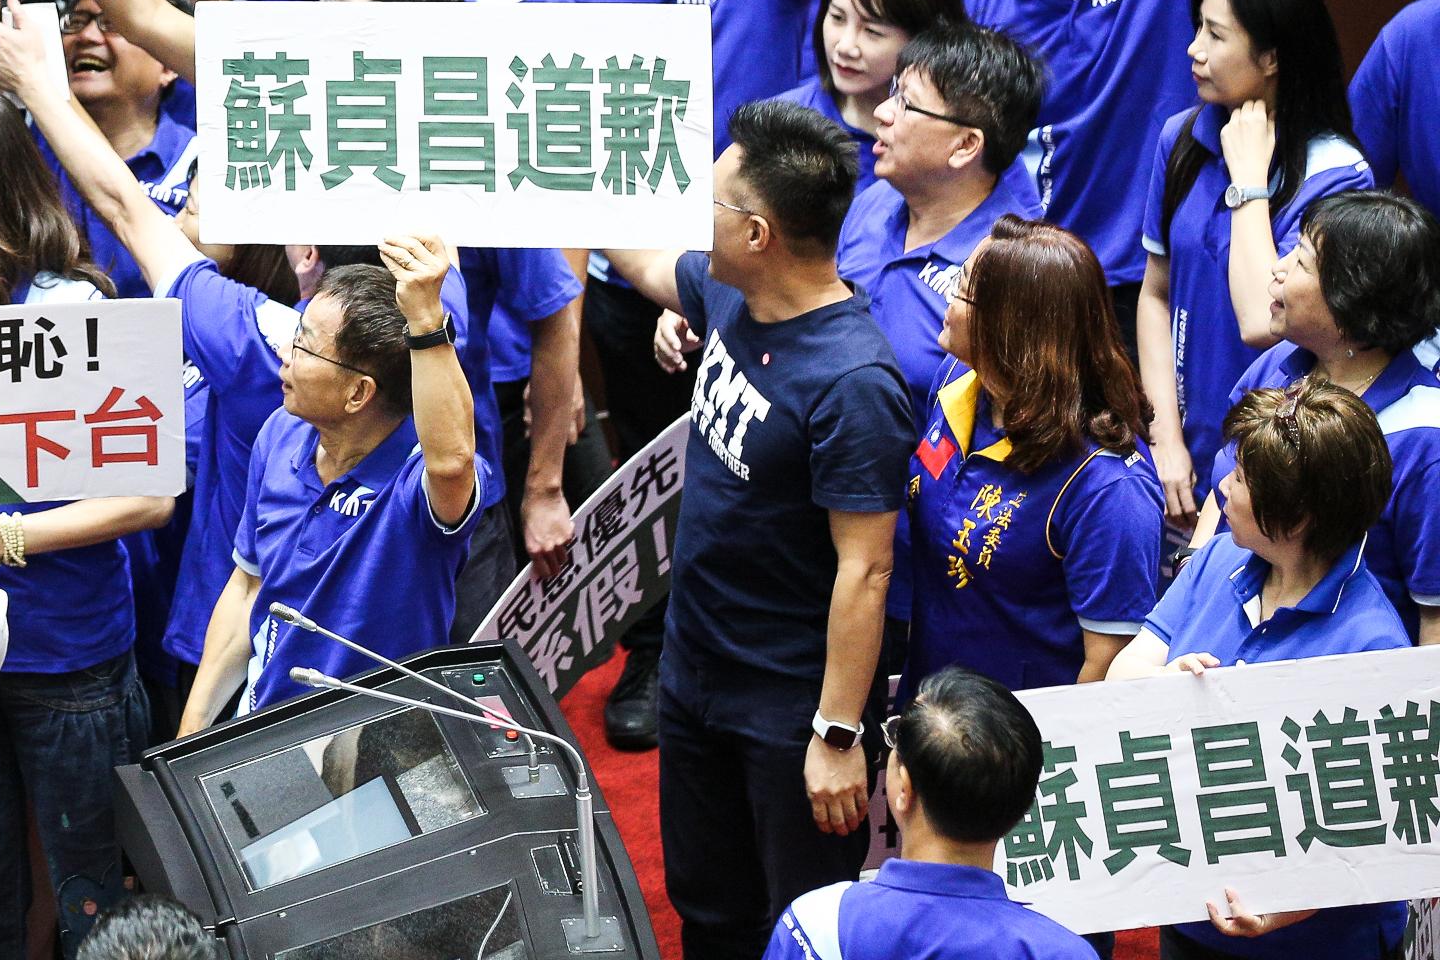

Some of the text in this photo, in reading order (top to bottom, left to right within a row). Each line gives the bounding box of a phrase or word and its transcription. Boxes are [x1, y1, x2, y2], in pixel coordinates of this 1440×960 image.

[222, 51, 691, 195] 蘇貞昌道歉
[138, 180, 189, 205] KMT
[918, 261, 954, 296] KM
[691, 327, 772, 459] KMT
[708, 426, 750, 481] TOGETHER
[947, 484, 1002, 589] 陳玉珍
[976, 490, 1028, 570] 立法委員
[1003, 700, 1440, 888] 蘇貞昌道歉
